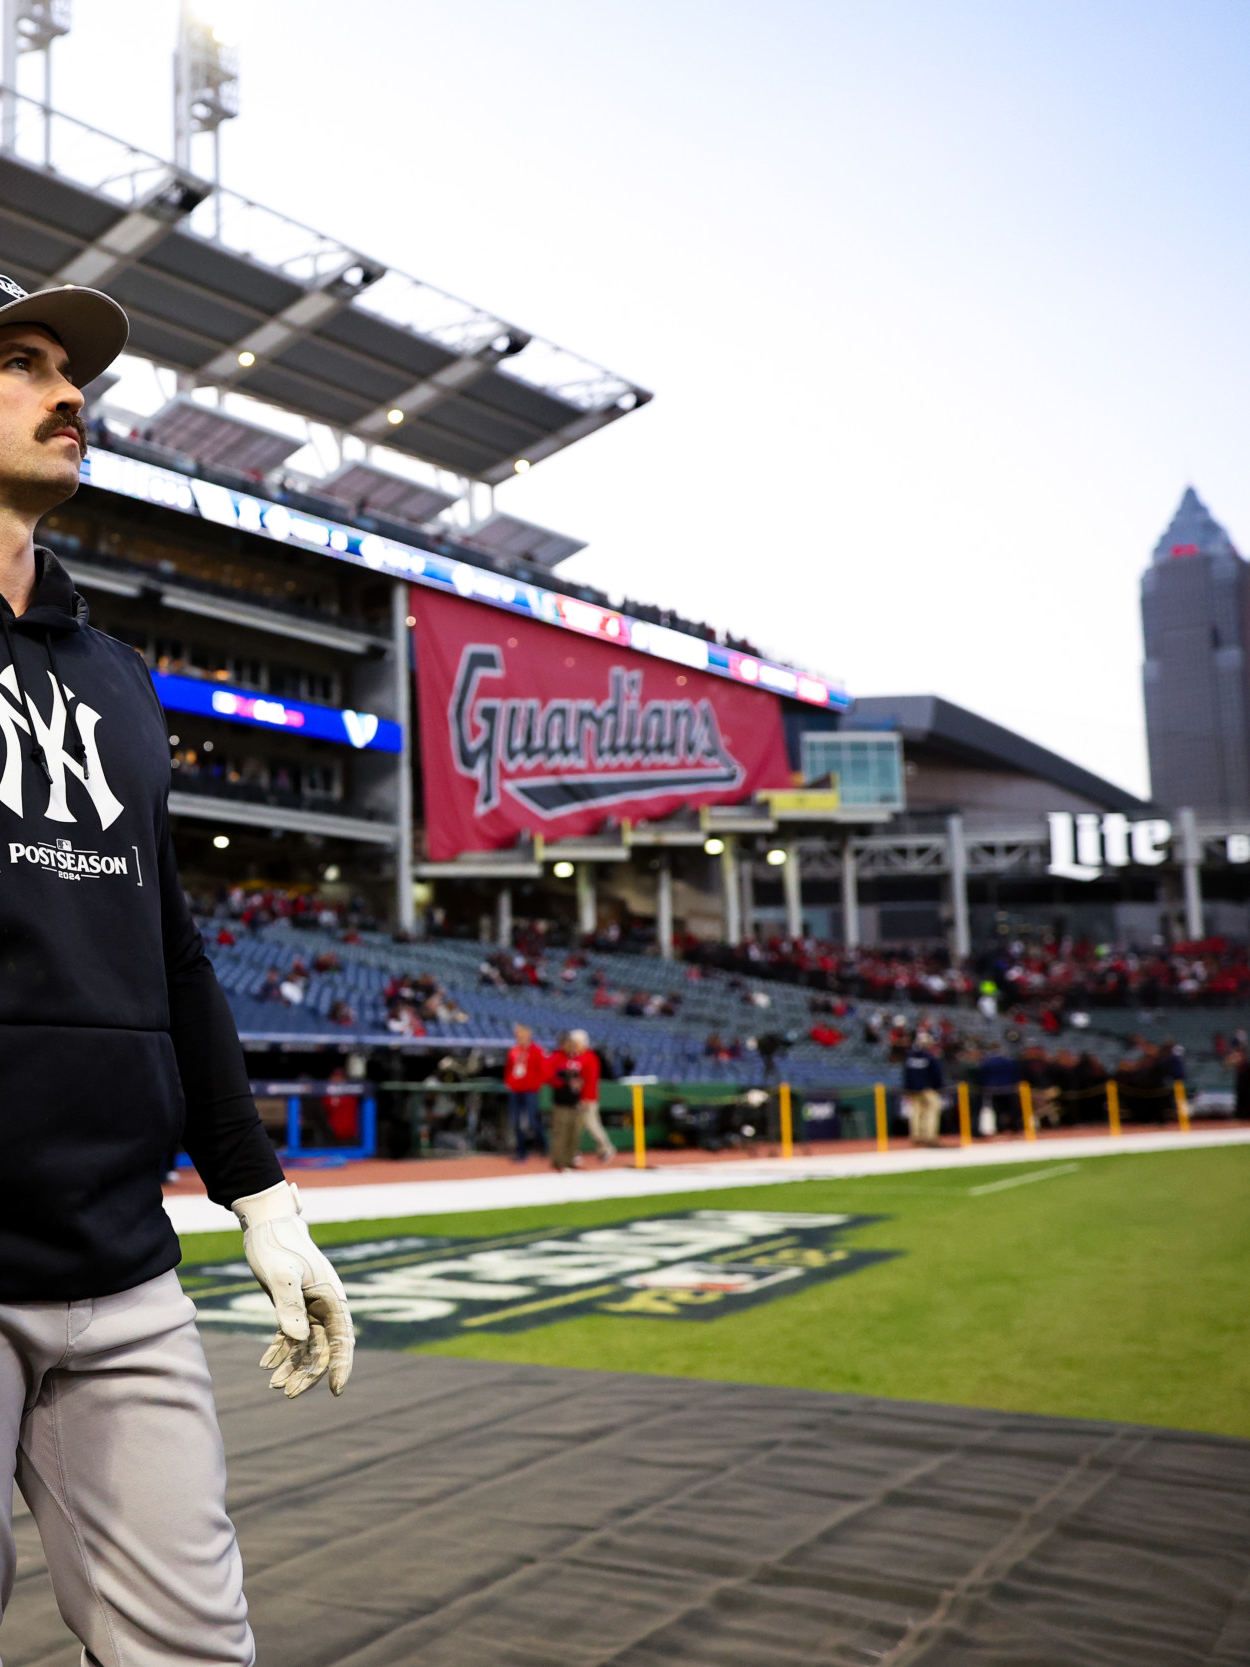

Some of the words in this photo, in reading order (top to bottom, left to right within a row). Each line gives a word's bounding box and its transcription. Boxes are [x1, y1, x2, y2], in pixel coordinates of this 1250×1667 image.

[448, 643, 742, 819] Guardians
[8, 843, 129, 875] POSTSEASON
[1048, 812, 1172, 882] Lite
[58, 870, 81, 881] 2024
